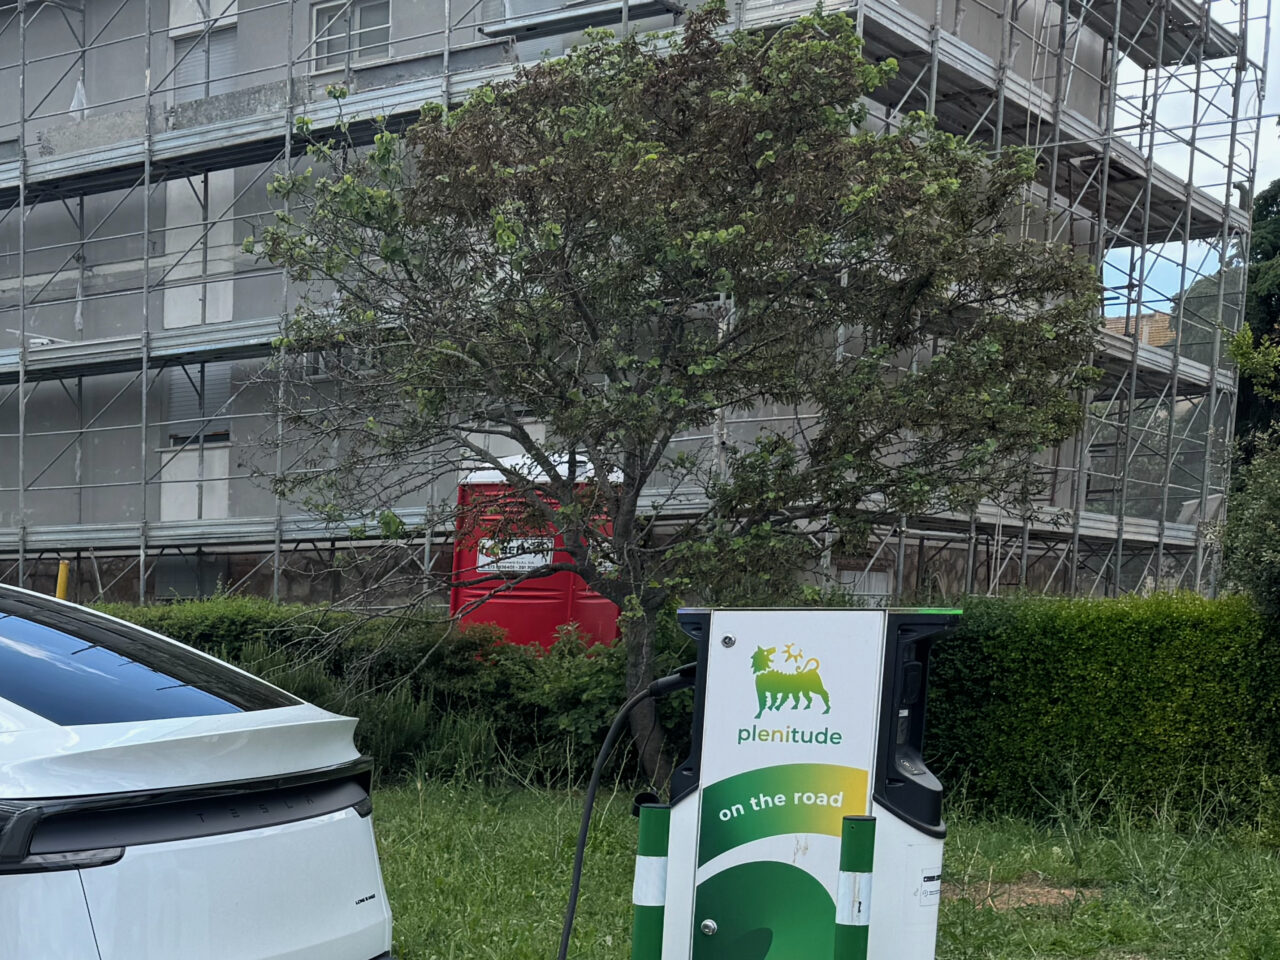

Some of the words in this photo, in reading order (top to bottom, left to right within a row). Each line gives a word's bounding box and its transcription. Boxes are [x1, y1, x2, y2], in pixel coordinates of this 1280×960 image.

[737, 724, 842, 745] plenitude
[196, 795, 315, 823] TESLA
[719, 803, 745, 821] on
[749, 793, 787, 811] the
[793, 791, 844, 808] road
